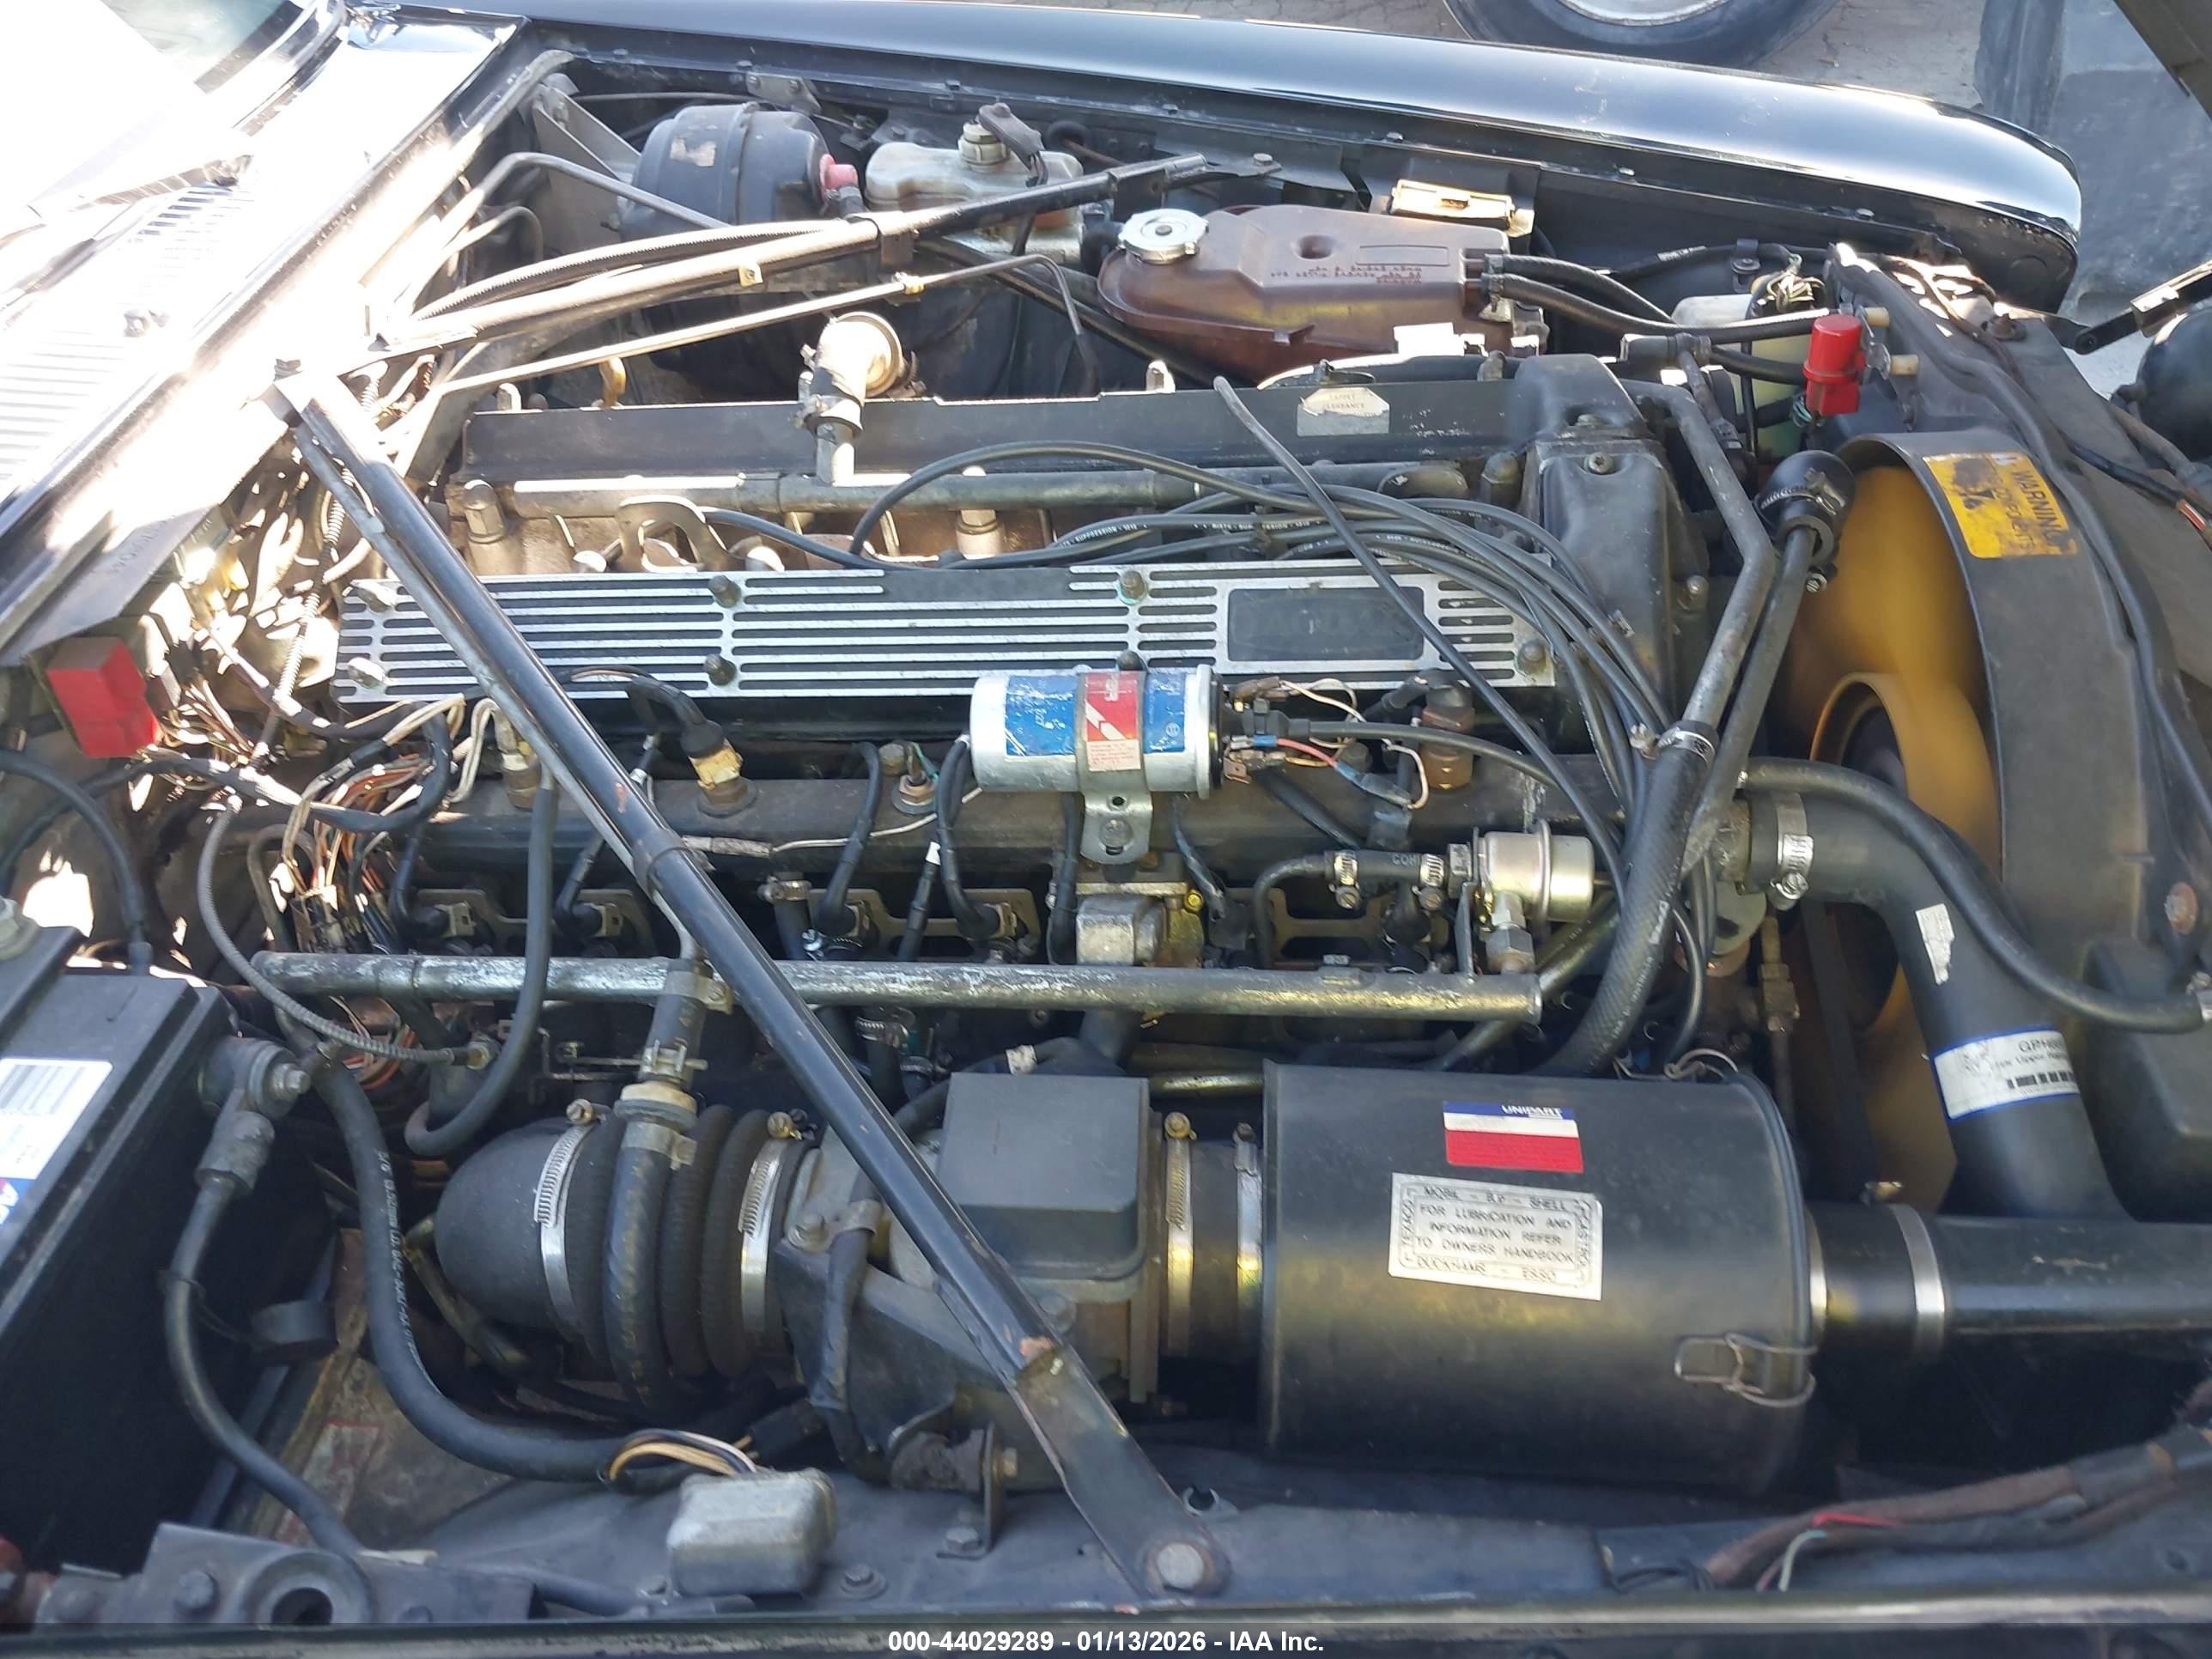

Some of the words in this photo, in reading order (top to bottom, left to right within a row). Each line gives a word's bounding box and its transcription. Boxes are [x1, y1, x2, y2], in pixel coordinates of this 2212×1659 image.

[1501, 1104, 1563, 1119] UNIPART
[1420, 1204, 1446, 1217] FOR
[1455, 1207, 1535, 1226] LUBRICATION
[1546, 1216, 1572, 1230] AND
[1430, 1222, 1511, 1240] INFORMATION
[1521, 1231, 1562, 1244] REFER
[1417, 1236, 1432, 1249] TO
[1443, 1239, 1496, 1255] OWNERS
[1504, 1246, 1575, 1265] HANDBOOK
